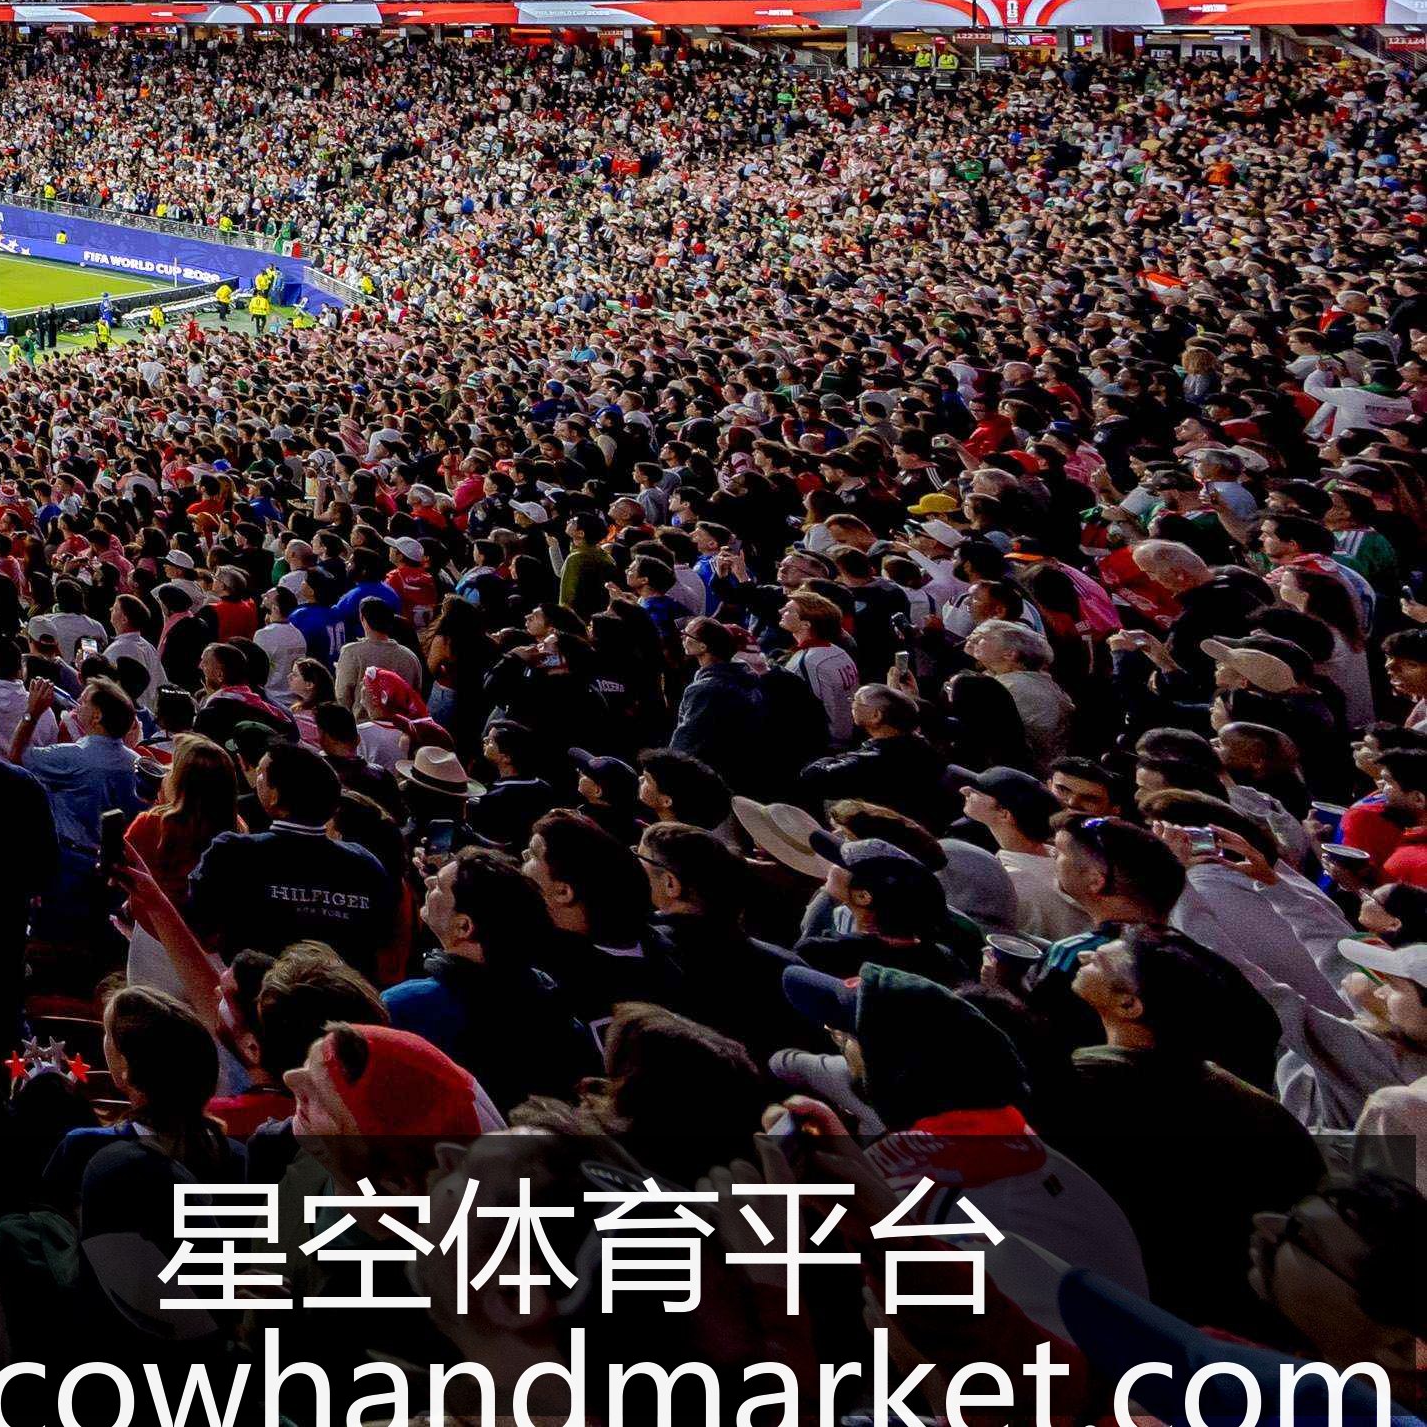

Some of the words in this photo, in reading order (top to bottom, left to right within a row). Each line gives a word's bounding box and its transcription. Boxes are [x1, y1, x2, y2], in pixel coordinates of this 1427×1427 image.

[83, 250, 110, 265] FIFA
[111, 255, 155, 272] WORLD
[155, 264, 182, 276] CUP
[271, 884, 370, 910] HILFIGER
